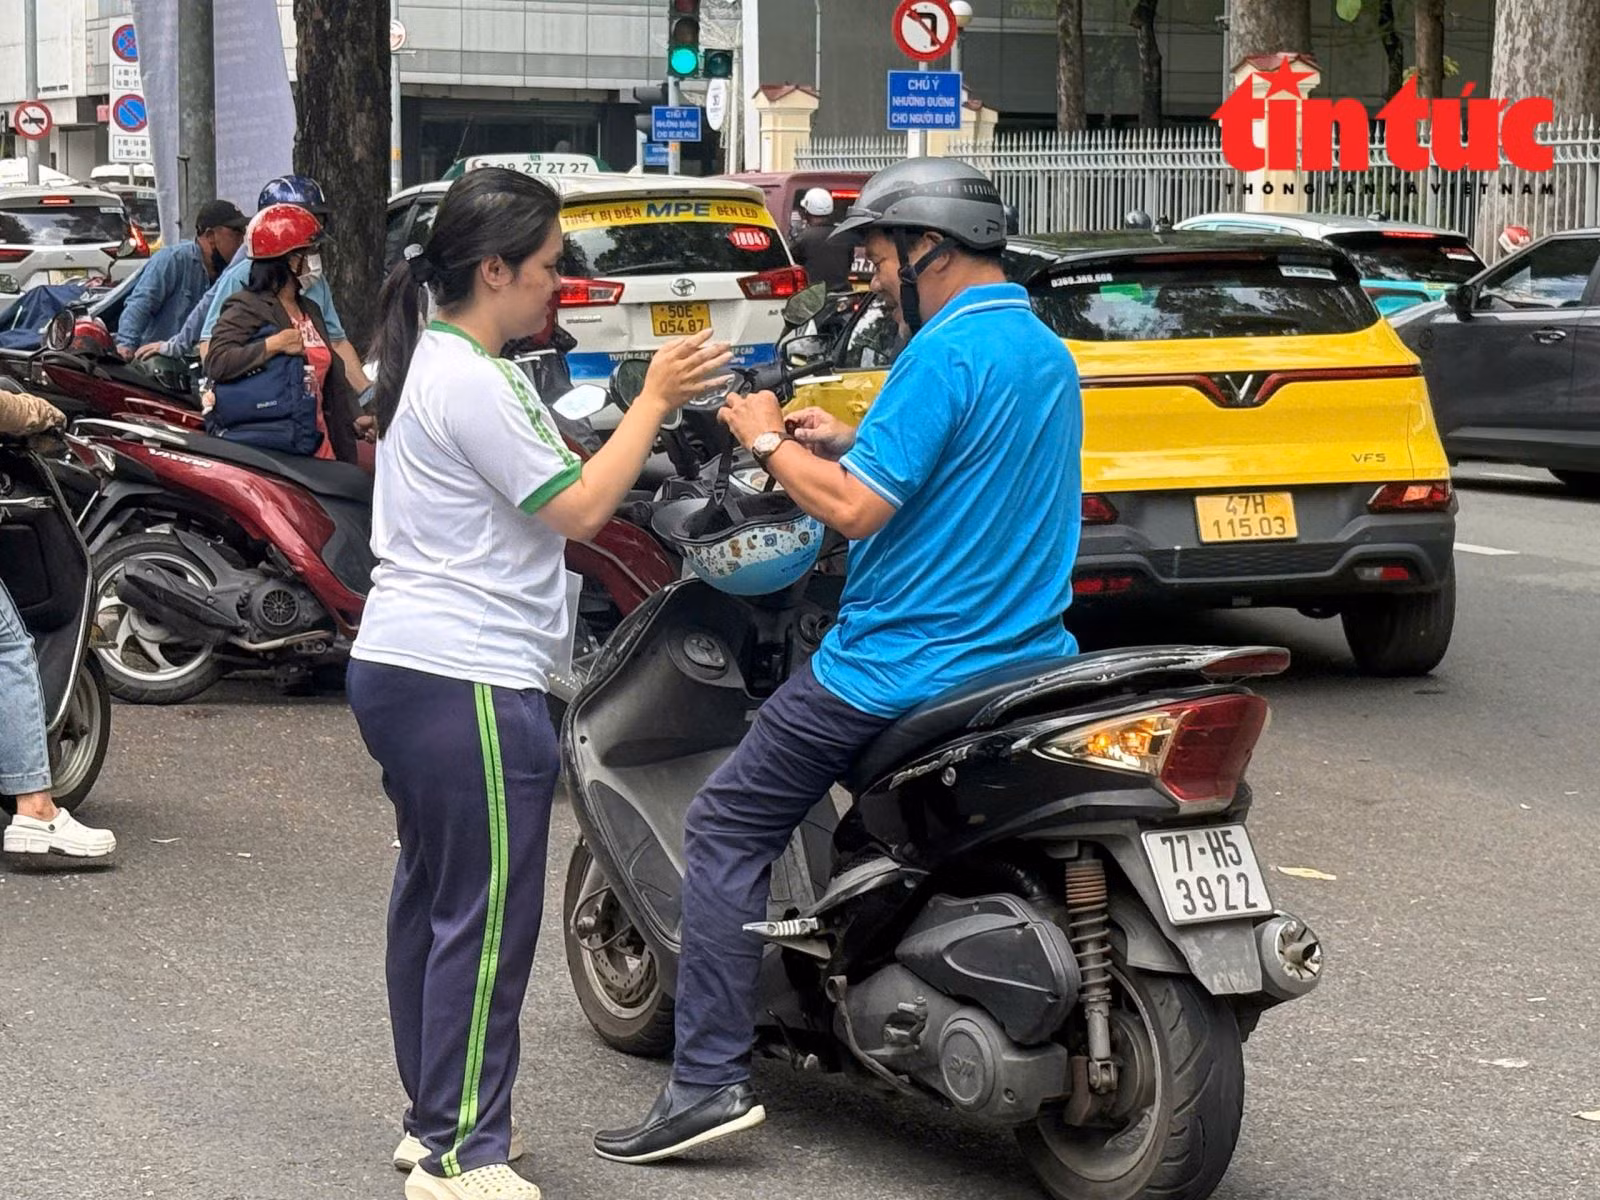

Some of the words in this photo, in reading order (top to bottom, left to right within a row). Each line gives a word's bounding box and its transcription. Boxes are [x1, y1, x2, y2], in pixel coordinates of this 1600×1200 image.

[908, 75, 930, 91] CHÚ
[891, 112, 908, 124] CHO
[523, 162, 542, 174] 27
[546, 162, 566, 174] 27
[569, 162, 589, 174] 27
[599, 209, 612, 222] BỊ
[613, 204, 642, 221] ĐIỆN
[647, 202, 711, 217] MPE
[740, 207, 758, 218] LED
[668, 304, 693, 318] 50E
[1225, 494, 1266, 515] 47H
[1213, 516, 1287, 539] 115.03
[1175, 871, 1258, 915] 3922
